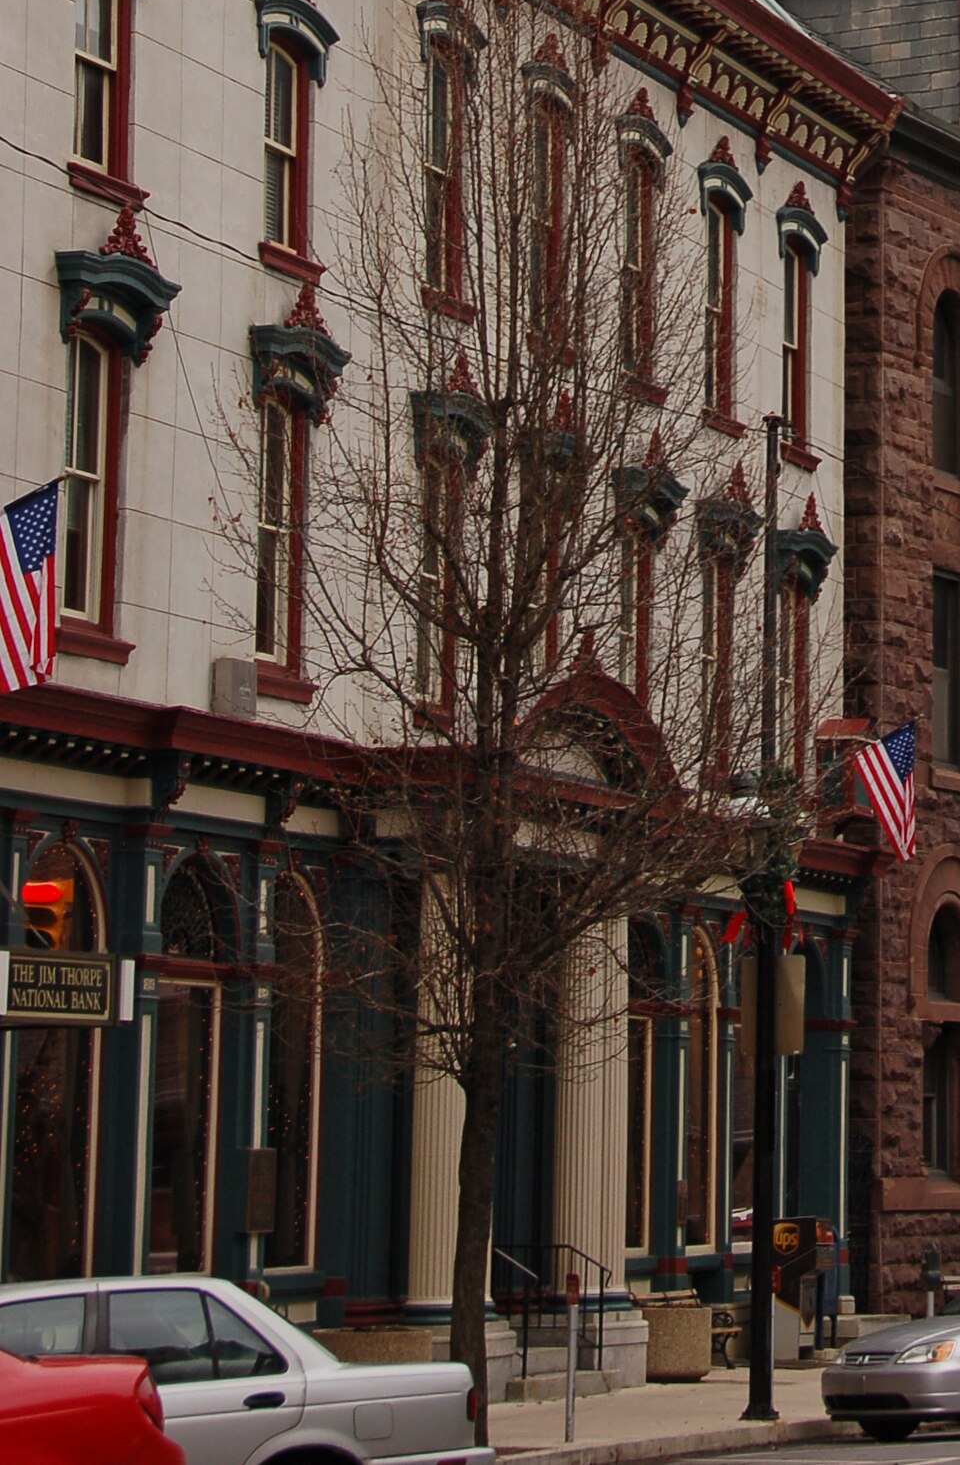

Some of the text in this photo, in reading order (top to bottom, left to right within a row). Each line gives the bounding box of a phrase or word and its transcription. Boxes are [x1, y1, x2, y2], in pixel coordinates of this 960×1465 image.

[12, 964, 102, 987] THE JIM THORPE
[12, 988, 101, 1010] NATIONAL BANK
[775, 1233, 797, 1250] ups
